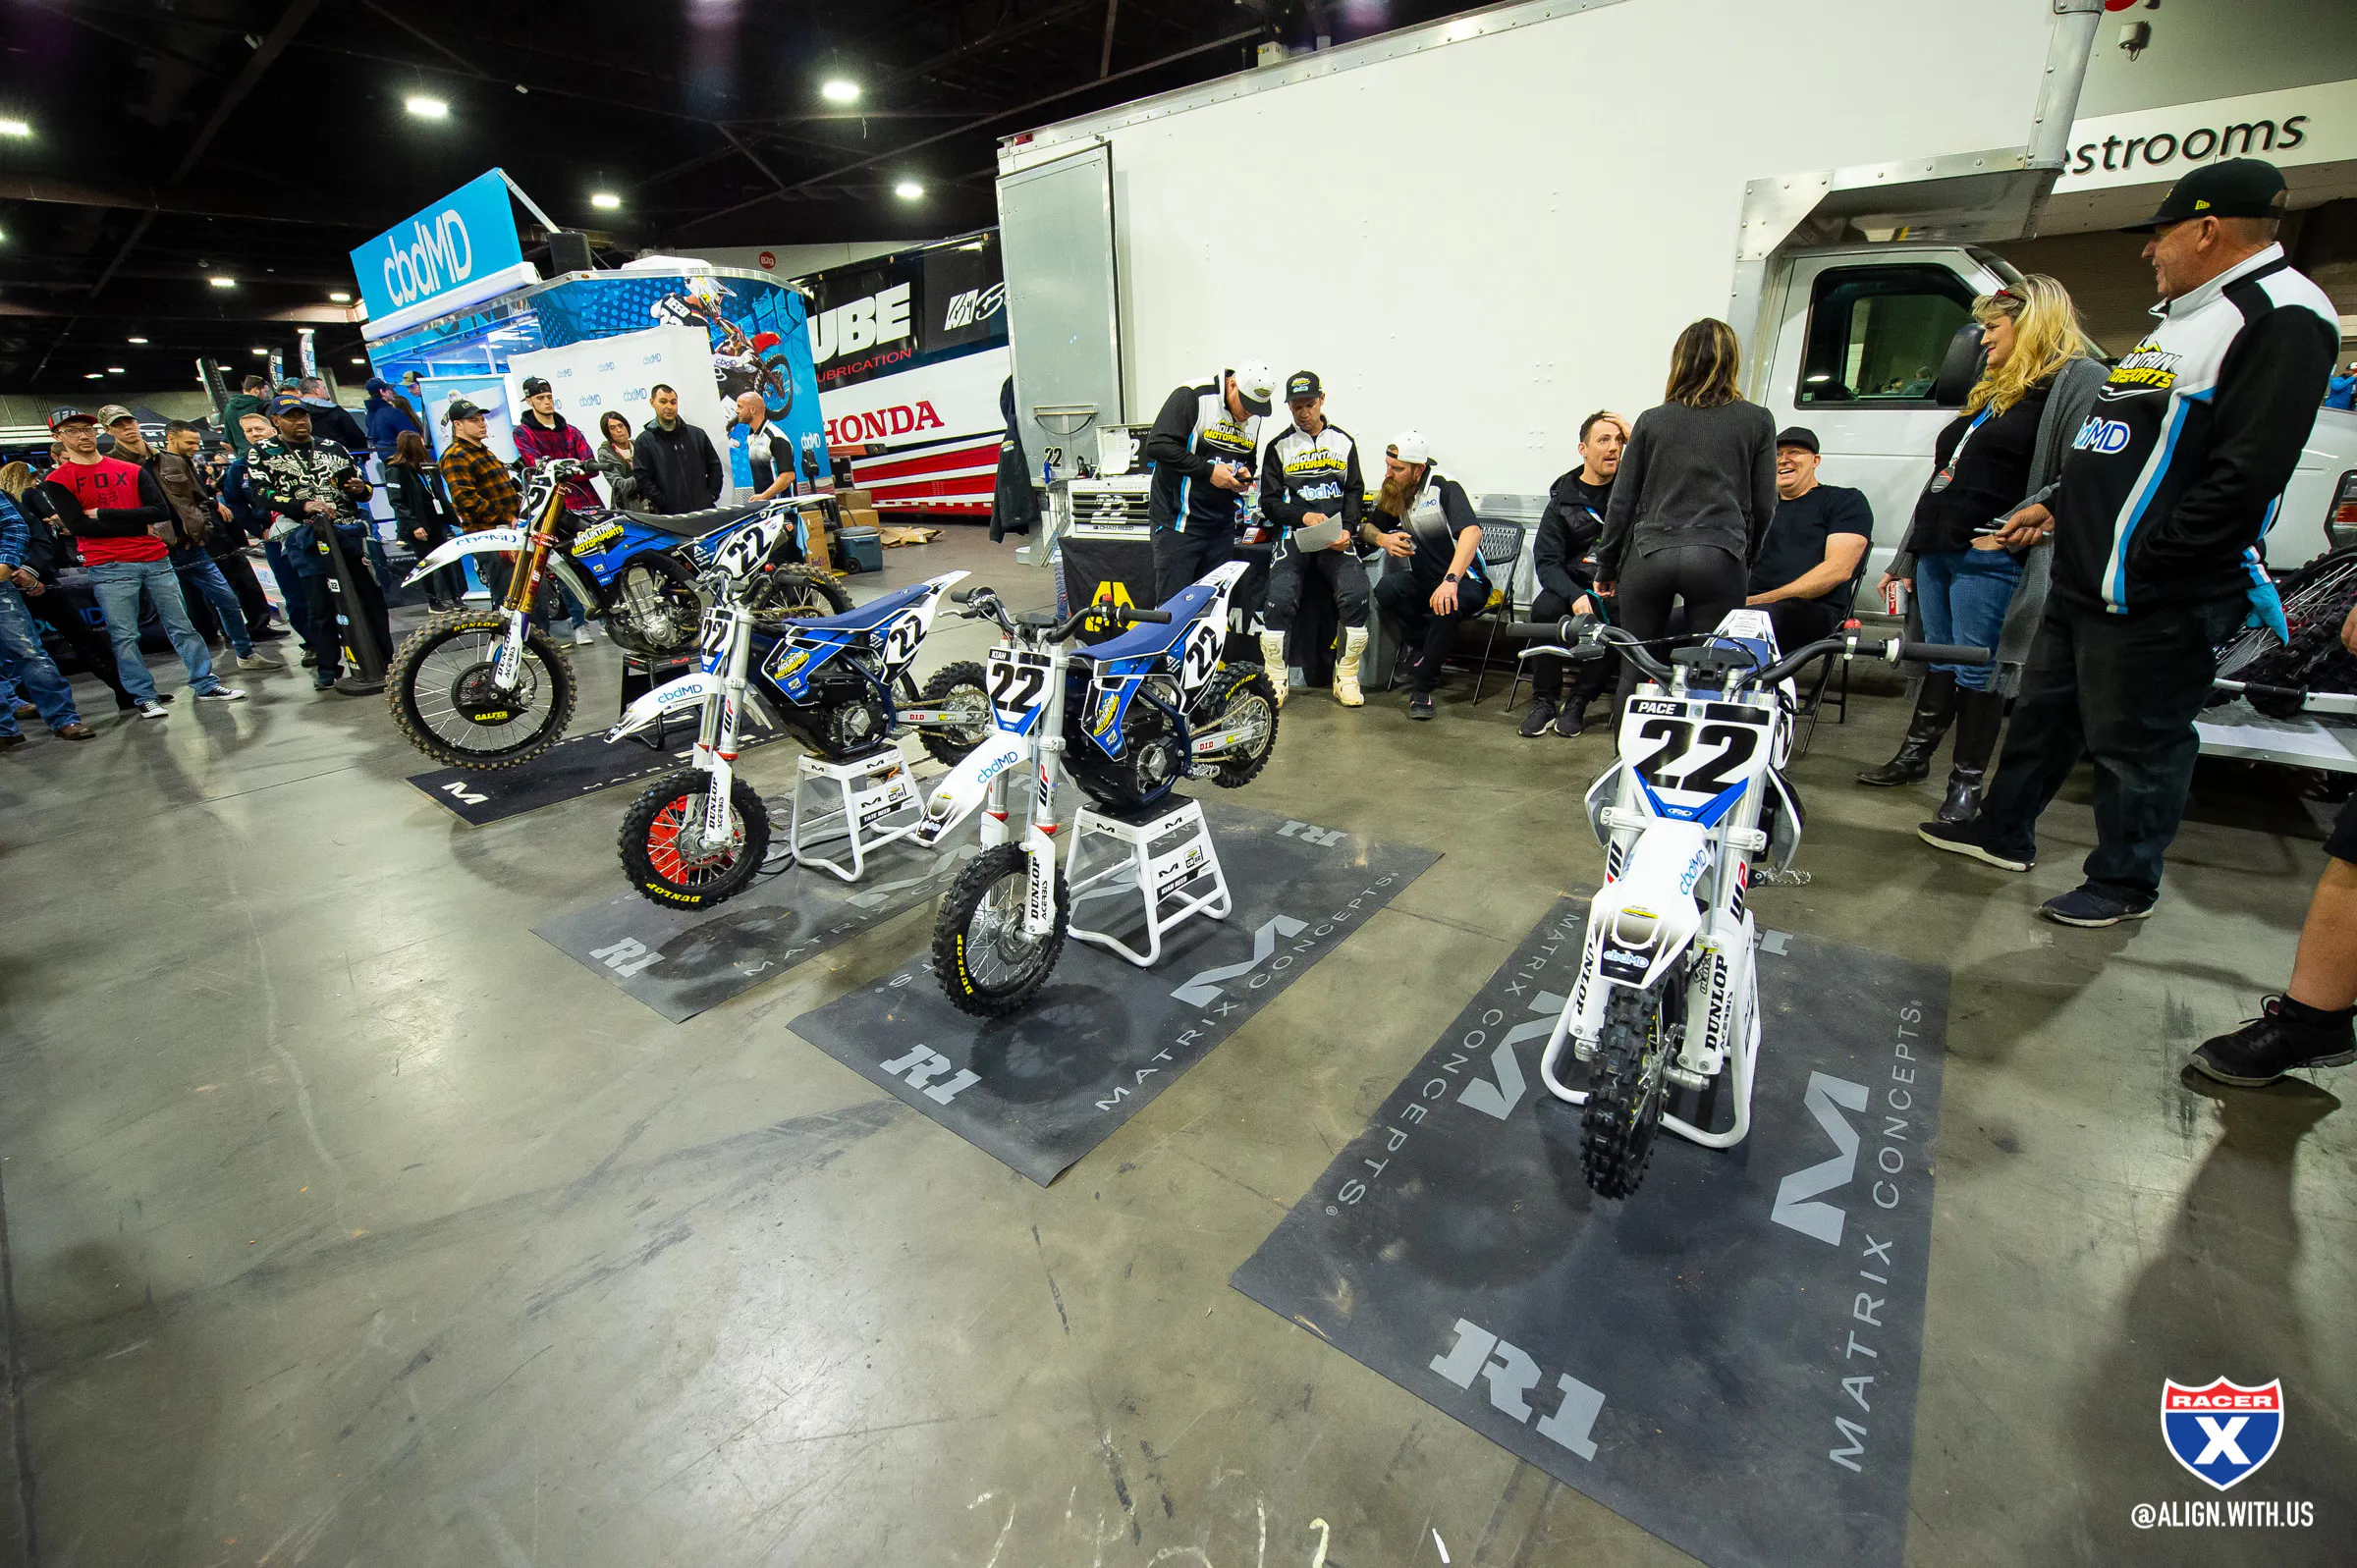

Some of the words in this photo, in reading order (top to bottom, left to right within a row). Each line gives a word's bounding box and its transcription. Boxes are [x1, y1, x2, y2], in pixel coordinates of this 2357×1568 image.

[384, 209, 472, 307] cbdMD
[2117, 351, 2183, 371] UNTAIN
[824, 401, 945, 447] HONDA
[1285, 458, 1347, 473] MOTORSPORTS
[1290, 452, 1343, 464] MOUNTAIN
[77, 471, 128, 493] FOX
[1296, 482, 1343, 501] cbdM
[1091, 494, 1129, 524] 22
[726, 526, 773, 576] 22
[454, 622, 499, 631] DUNLOP
[701, 619, 728, 657] 22
[890, 615, 927, 662] 22
[991, 651, 1007, 660] KIAH
[1185, 625, 1223, 682] 22
[658, 684, 702, 704] cbdMD
[990, 663, 1044, 715] 22
[1637, 701, 1676, 715] PACE
[474, 711, 508, 721] GALFER
[977, 751, 1018, 784] cbdMD
[1634, 719, 1758, 795] 22
[708, 777, 718, 831] DUNLOP
[864, 813, 877, 822] TATE
[1031, 857, 1040, 920] DUNLOP
[1679, 849, 1707, 895] cbdMD
[645, 883, 701, 903] DUNLOP
[957, 934, 974, 996] DUNLOP
[1505, 911, 1582, 997] MATRIX
[1603, 948, 1650, 969] cbdMD
[1705, 954, 1728, 1053] DUNLOP
[1095, 1000, 1239, 1112] MATRIX
[1830, 1233, 1895, 1474] MATRIX
